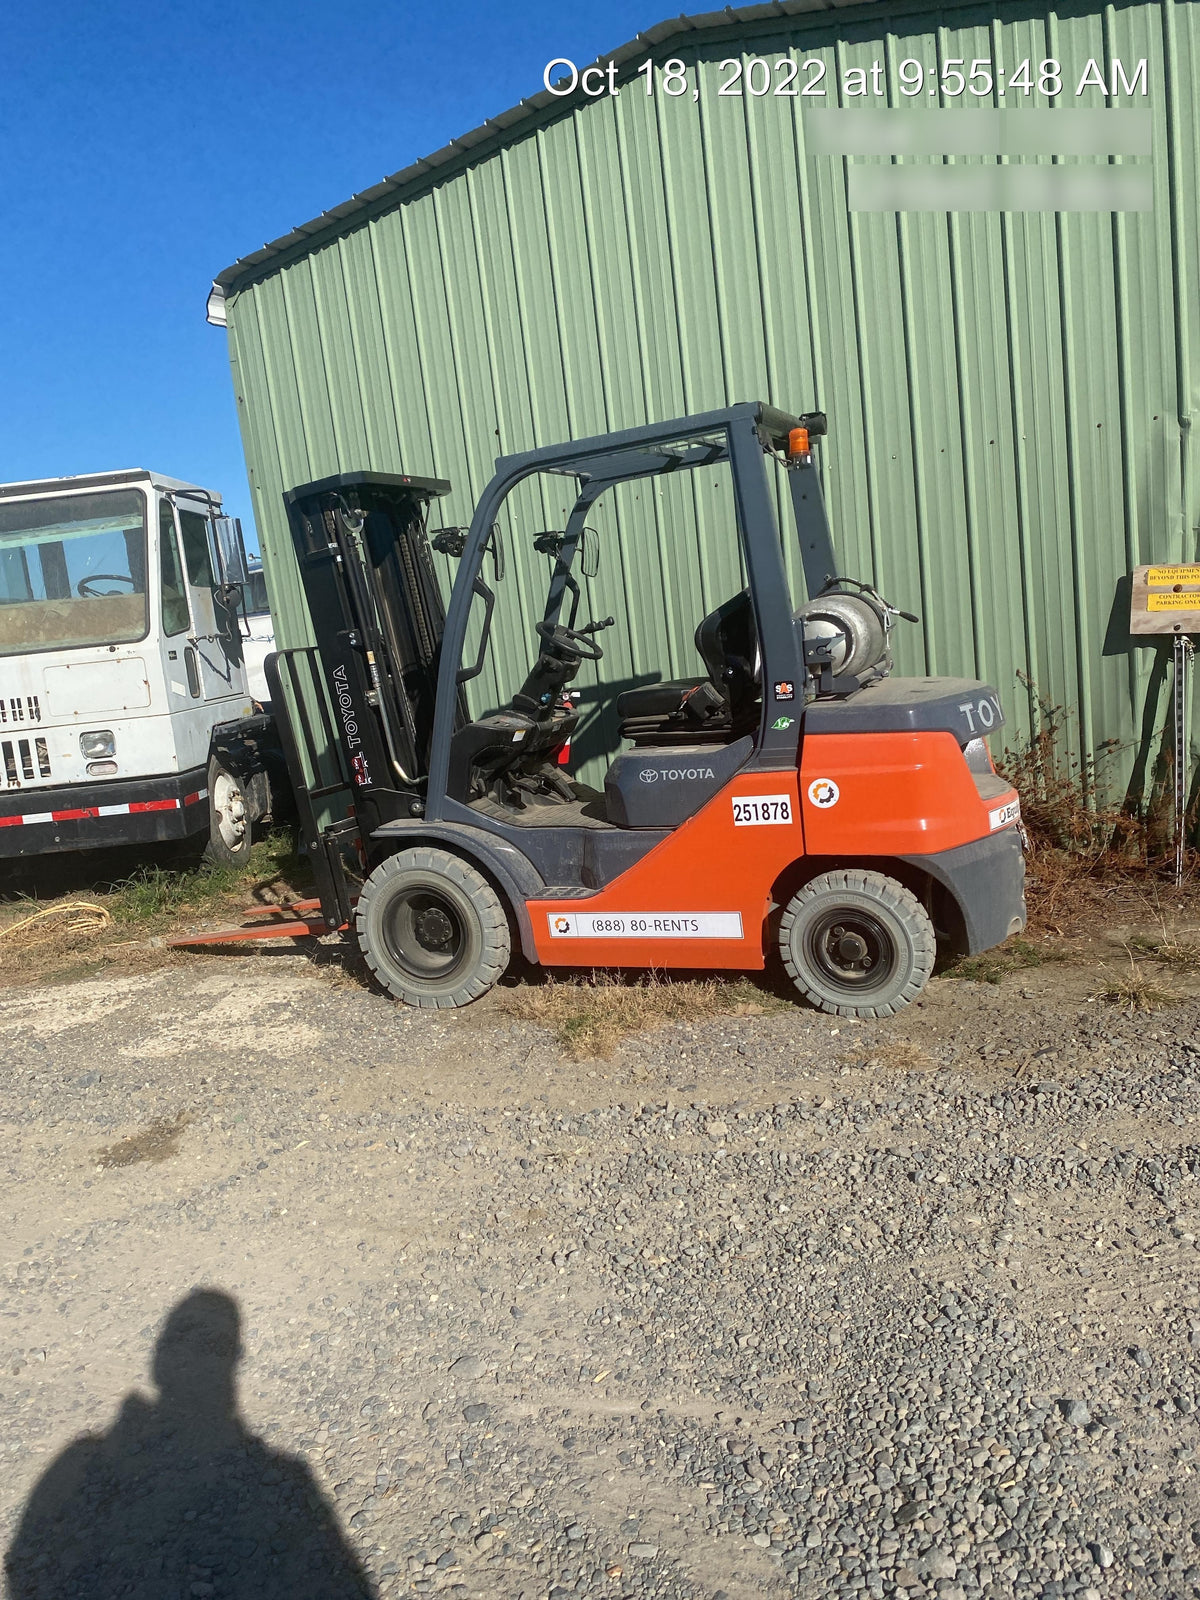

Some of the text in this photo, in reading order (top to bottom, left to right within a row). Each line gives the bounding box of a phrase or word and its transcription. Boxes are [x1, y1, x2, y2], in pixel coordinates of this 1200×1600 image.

[775, 682, 793, 694] SAS
[332, 664, 361, 749] TOYOTA
[660, 768, 715, 781] TOYOTA
[733, 801, 790, 822] 251878
[592, 919, 699, 933] (888) 80-RENTS
